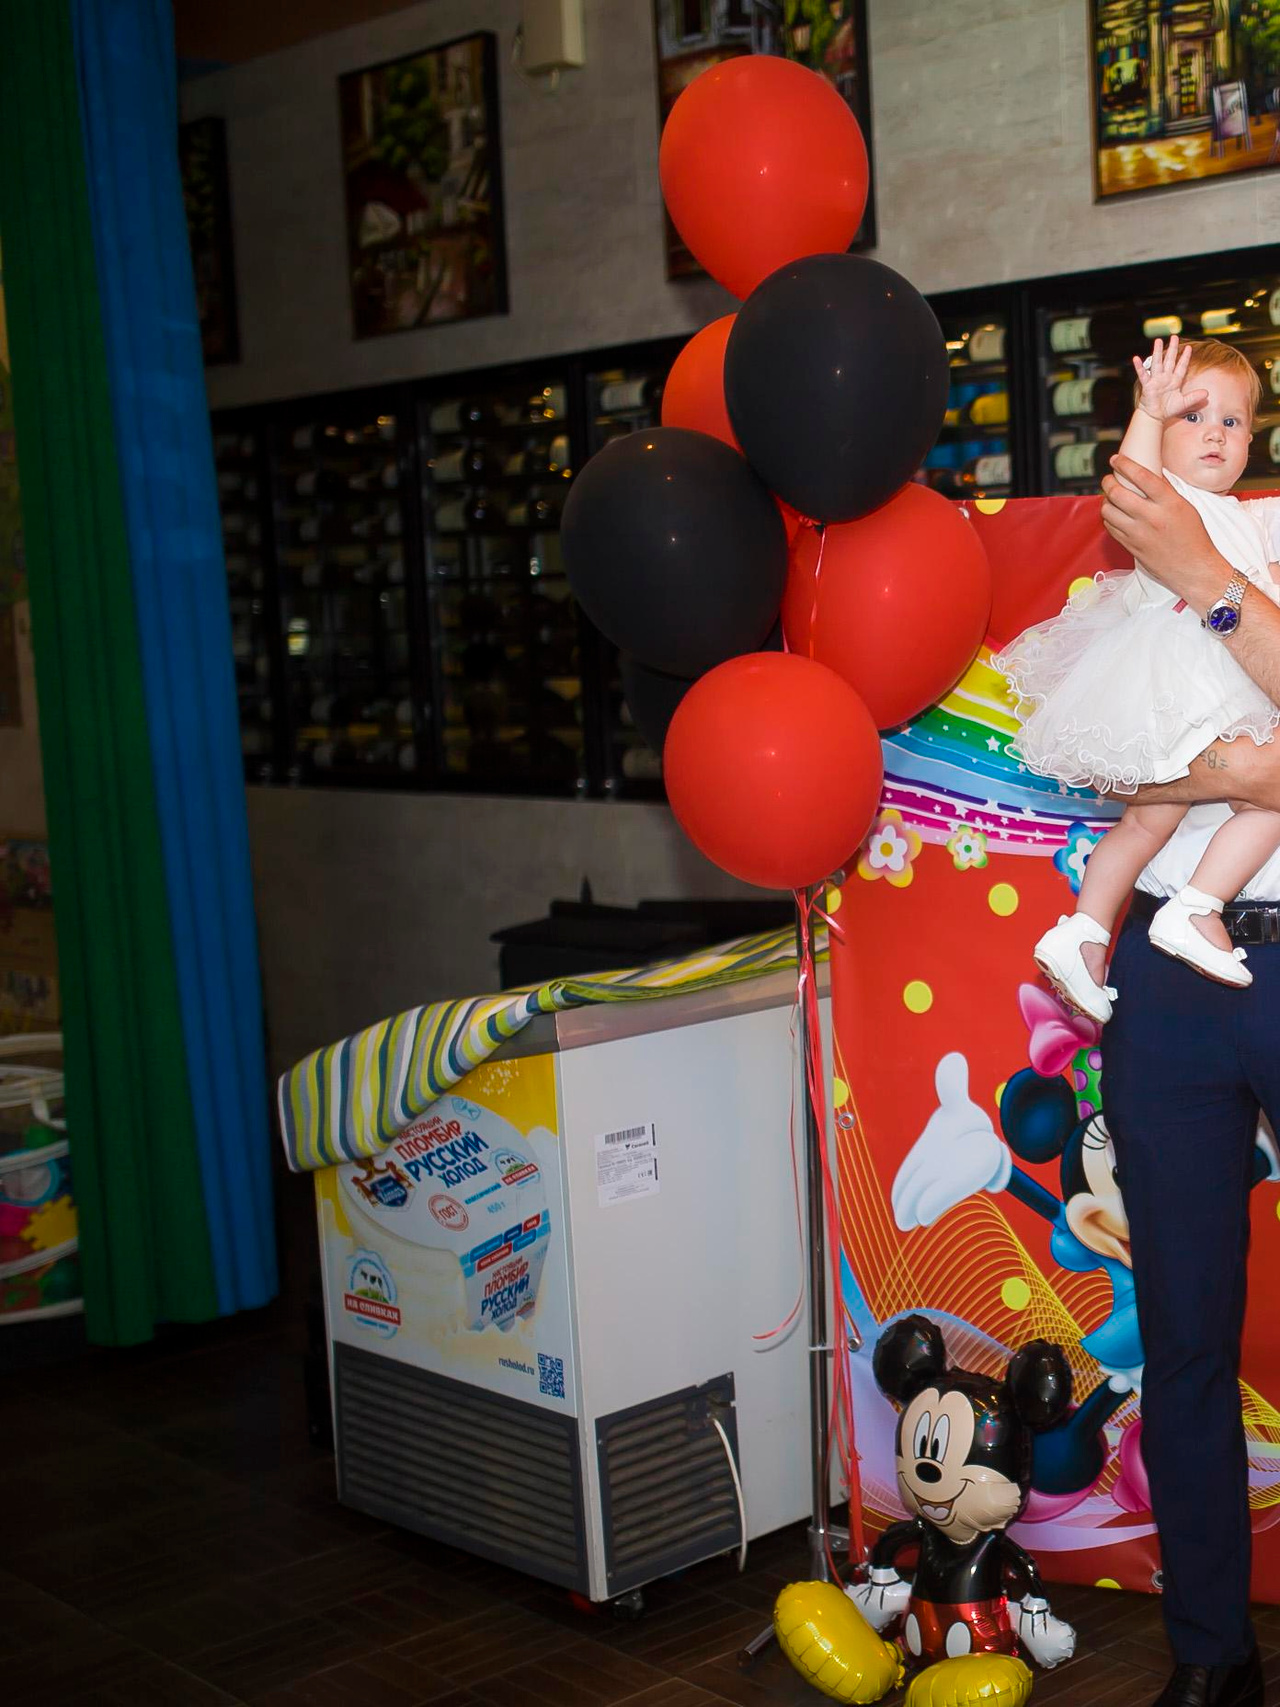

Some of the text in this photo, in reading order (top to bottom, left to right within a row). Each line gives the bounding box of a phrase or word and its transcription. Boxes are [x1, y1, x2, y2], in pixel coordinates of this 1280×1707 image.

[394, 1120, 462, 1161] ПЛОМБИР
[403, 1131, 489, 1182] РУССКИЙ
[437, 1157, 488, 1188] ХОЛОД
[439, 1205, 458, 1220] ГОСТ
[481, 1274, 530, 1316] РУССКИЙ
